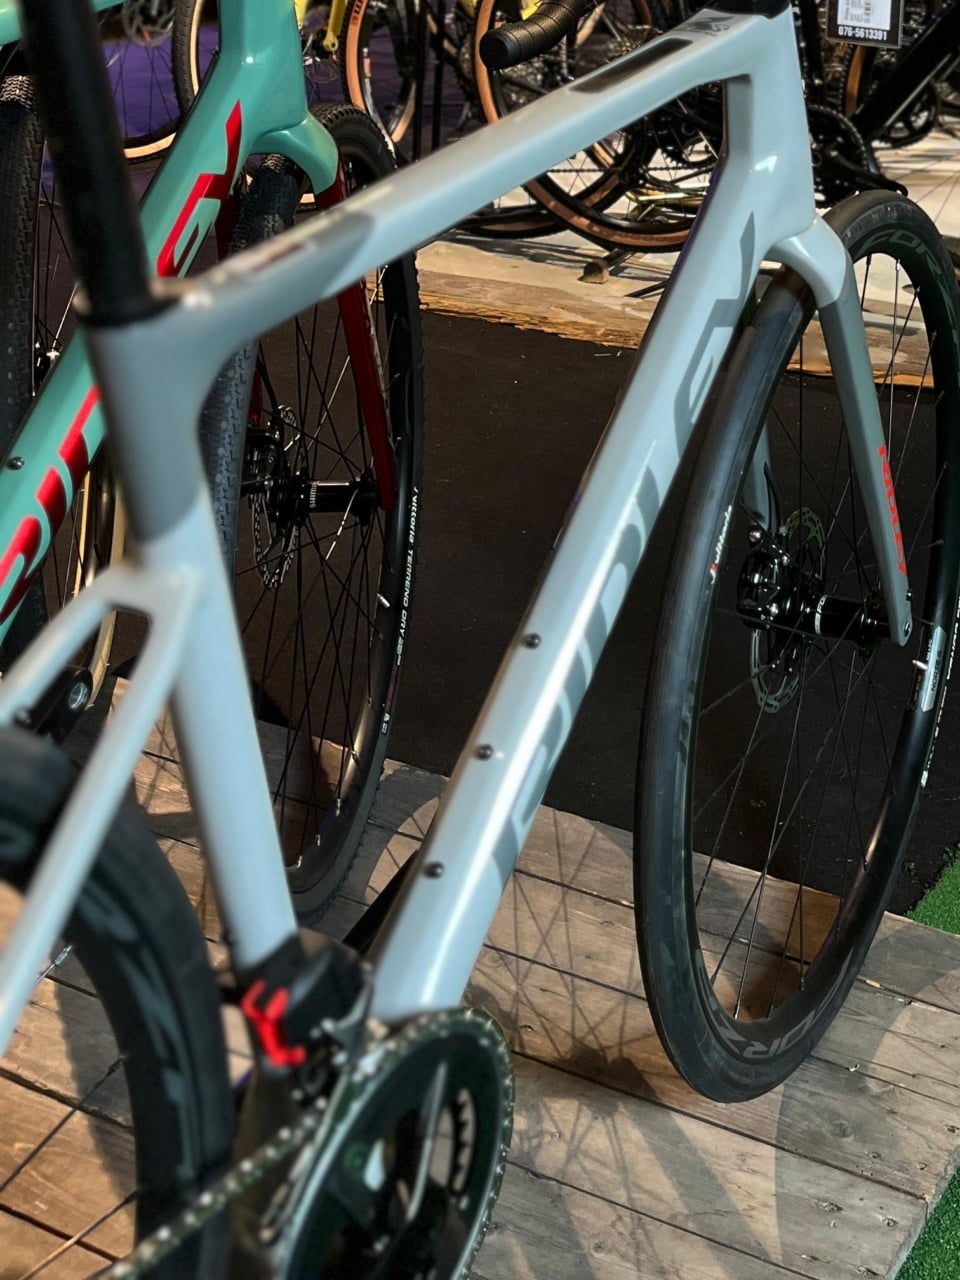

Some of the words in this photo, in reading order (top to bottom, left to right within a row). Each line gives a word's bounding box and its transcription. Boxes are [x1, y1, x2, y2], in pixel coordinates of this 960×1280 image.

[877, 445, 907, 577] RIDLEY
[402, 548, 414, 607] TERRENO
[398, 609, 408, 637] DRY
